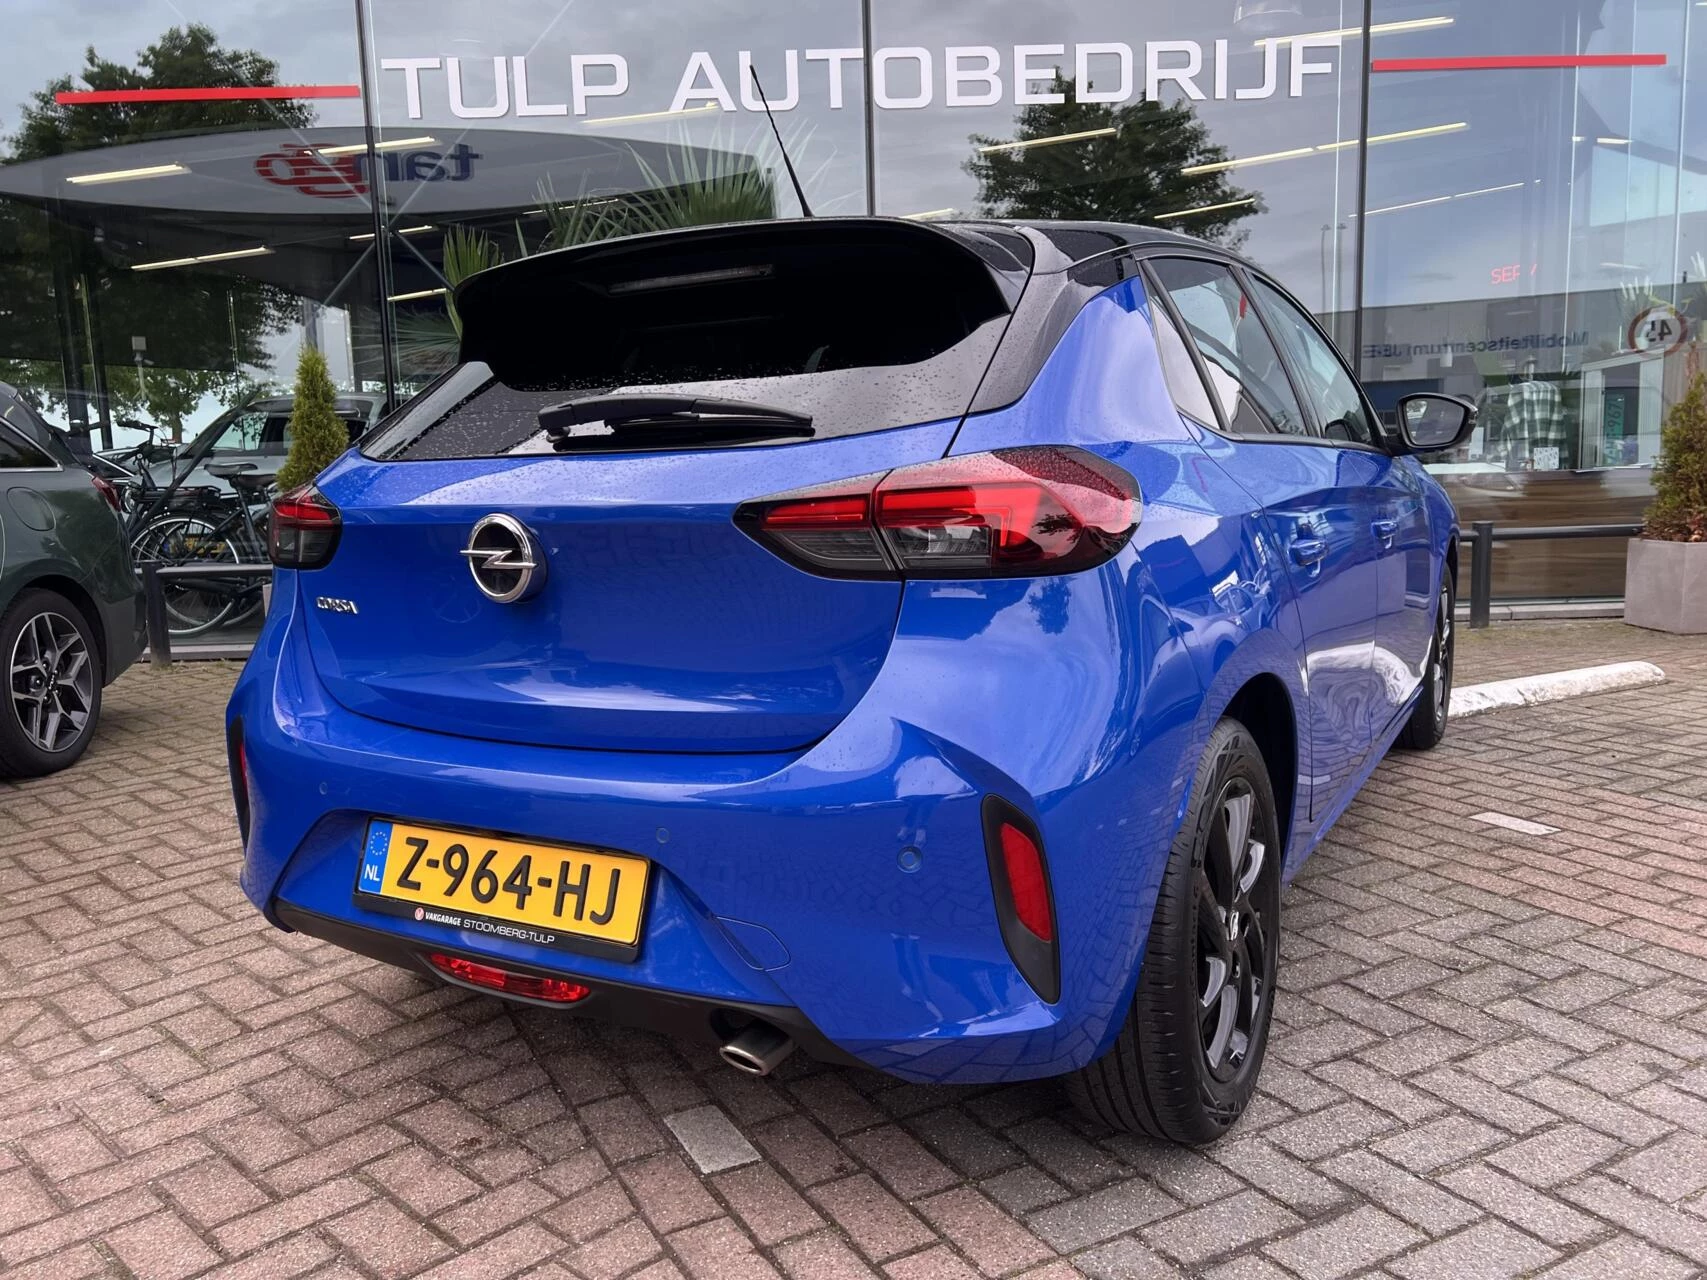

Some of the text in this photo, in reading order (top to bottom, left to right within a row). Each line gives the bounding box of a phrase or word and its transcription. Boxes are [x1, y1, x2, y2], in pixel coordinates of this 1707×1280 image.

[381, 36, 1341, 119] TULP AUTOBEDRIJF
[364, 863, 381, 883] NL
[396, 836, 621, 926] Z-964-HJ
[425, 911, 555, 944] VAKGARAGE STOOMBERG-TULP
